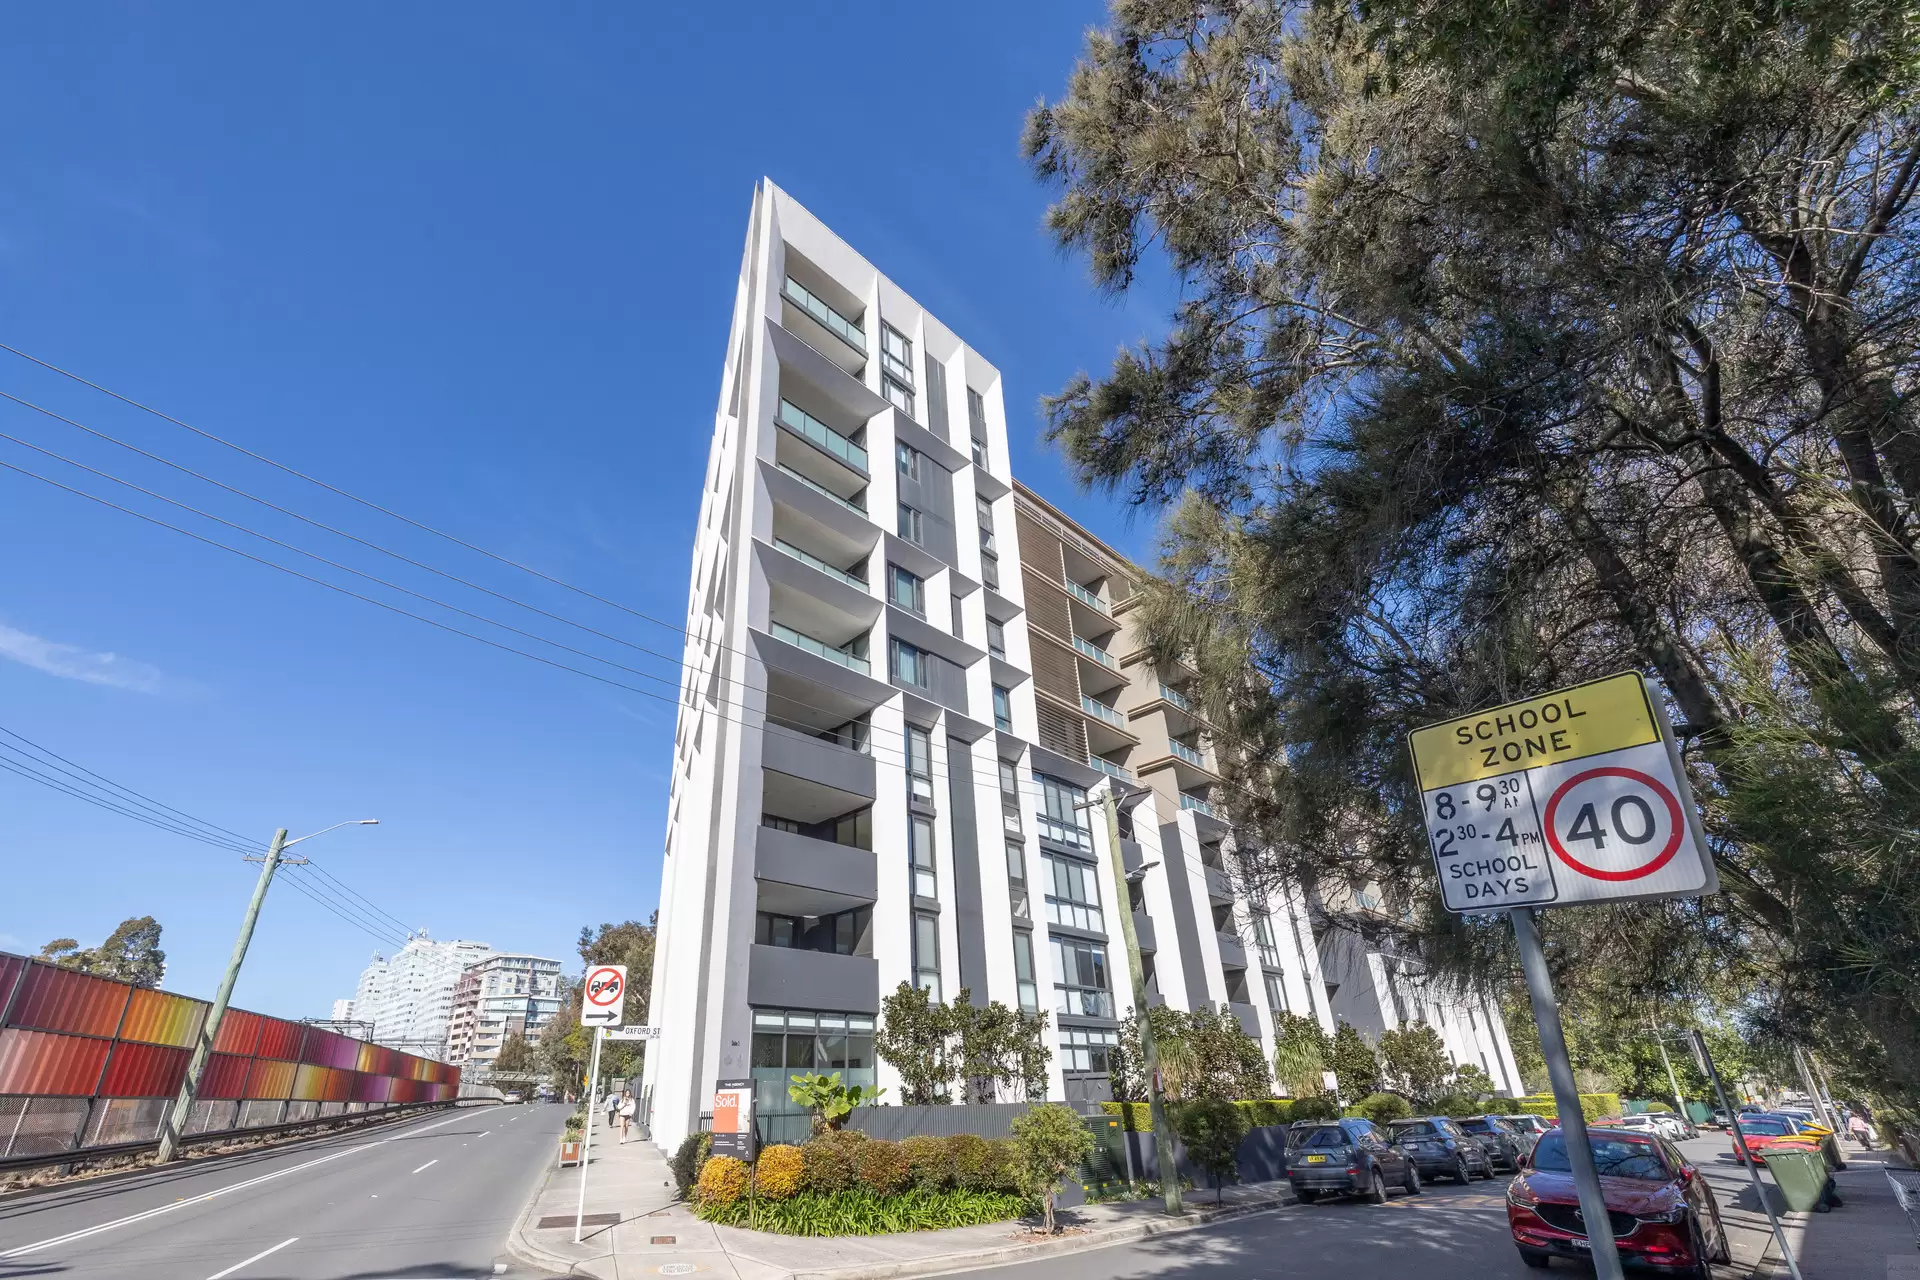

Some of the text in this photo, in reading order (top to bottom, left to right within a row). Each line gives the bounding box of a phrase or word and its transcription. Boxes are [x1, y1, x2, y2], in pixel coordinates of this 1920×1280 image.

[1455, 699, 1587, 746] SCHOOL
[1480, 729, 1572, 769] ZONE
[1566, 794, 1656, 850] 40
[1521, 832, 1541, 846] PM
[1449, 854, 1538, 879] SCHOOL
[1464, 877, 1530, 899] DAYS
[625, 1027, 660, 1035] OXFORD ST
[715, 1095, 738, 1108] Sold.
